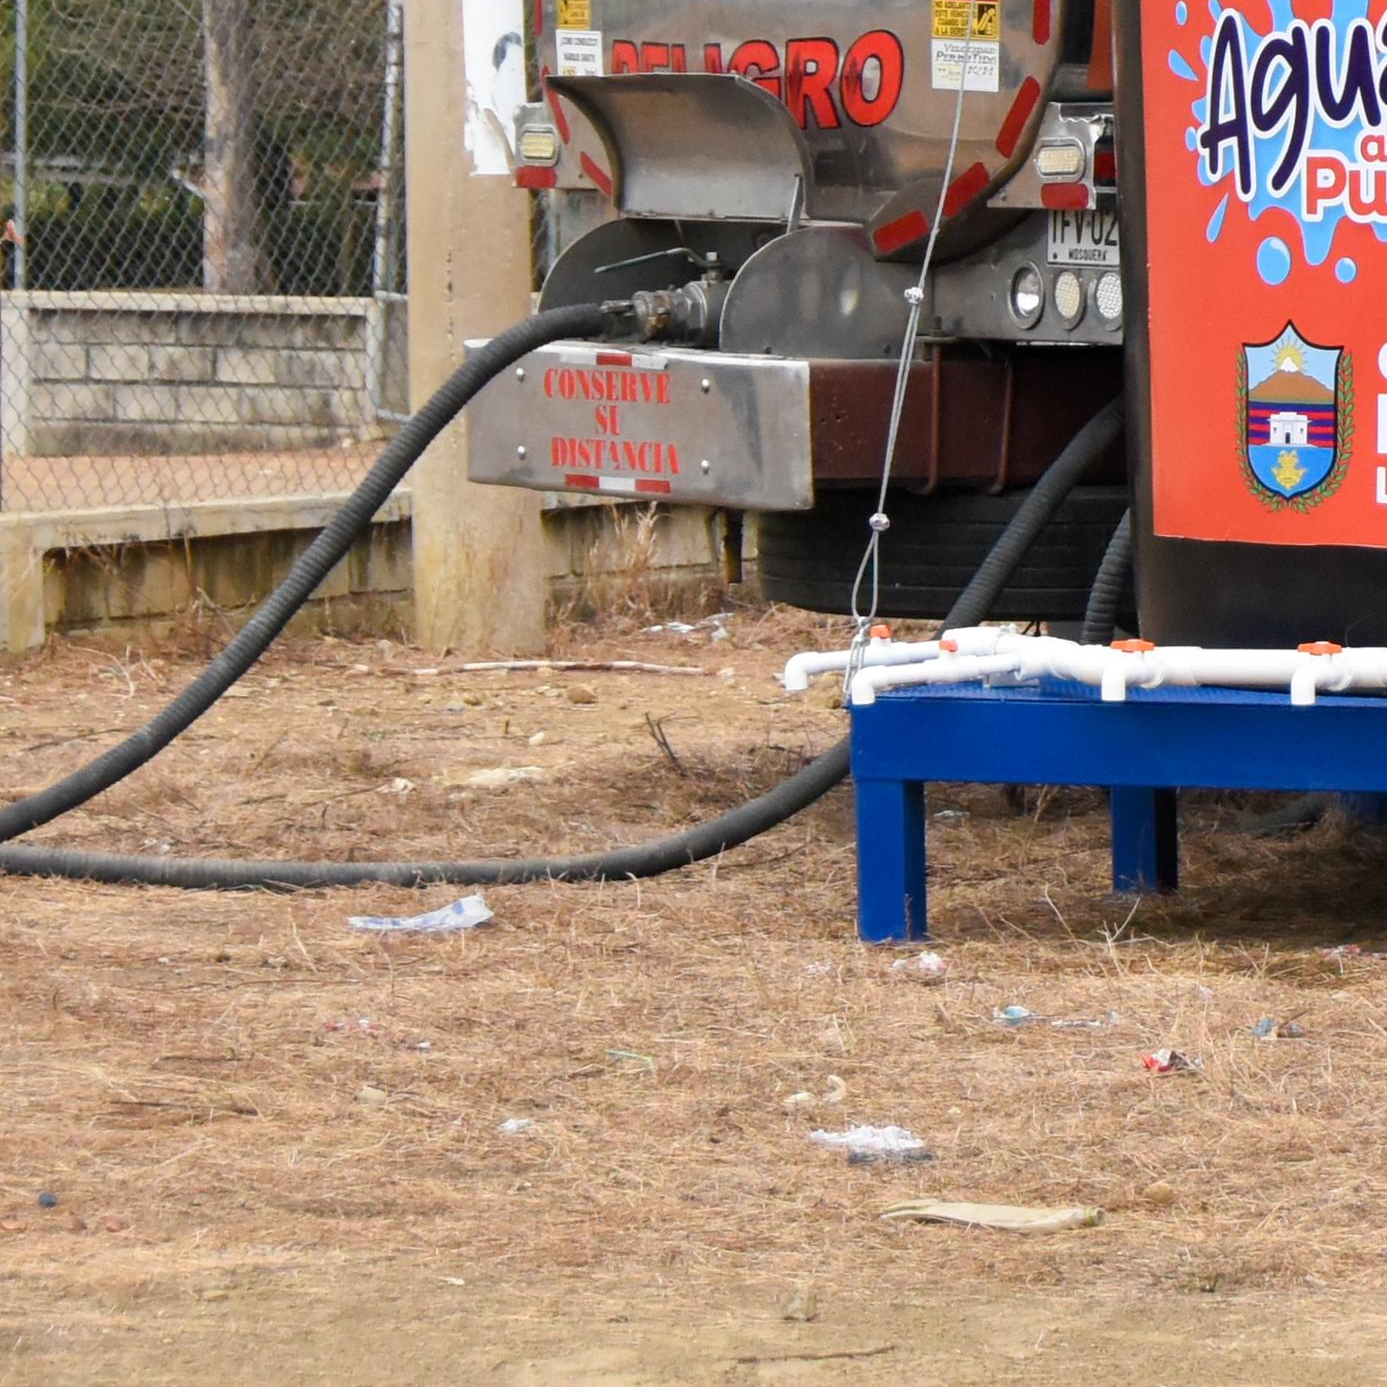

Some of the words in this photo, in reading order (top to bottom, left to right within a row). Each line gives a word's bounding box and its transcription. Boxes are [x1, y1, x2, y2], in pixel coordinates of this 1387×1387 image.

[544, 367, 672, 404] CONSERVE
[594, 404, 620, 435] SU
[551, 435, 679, 475] DISTANCIA
